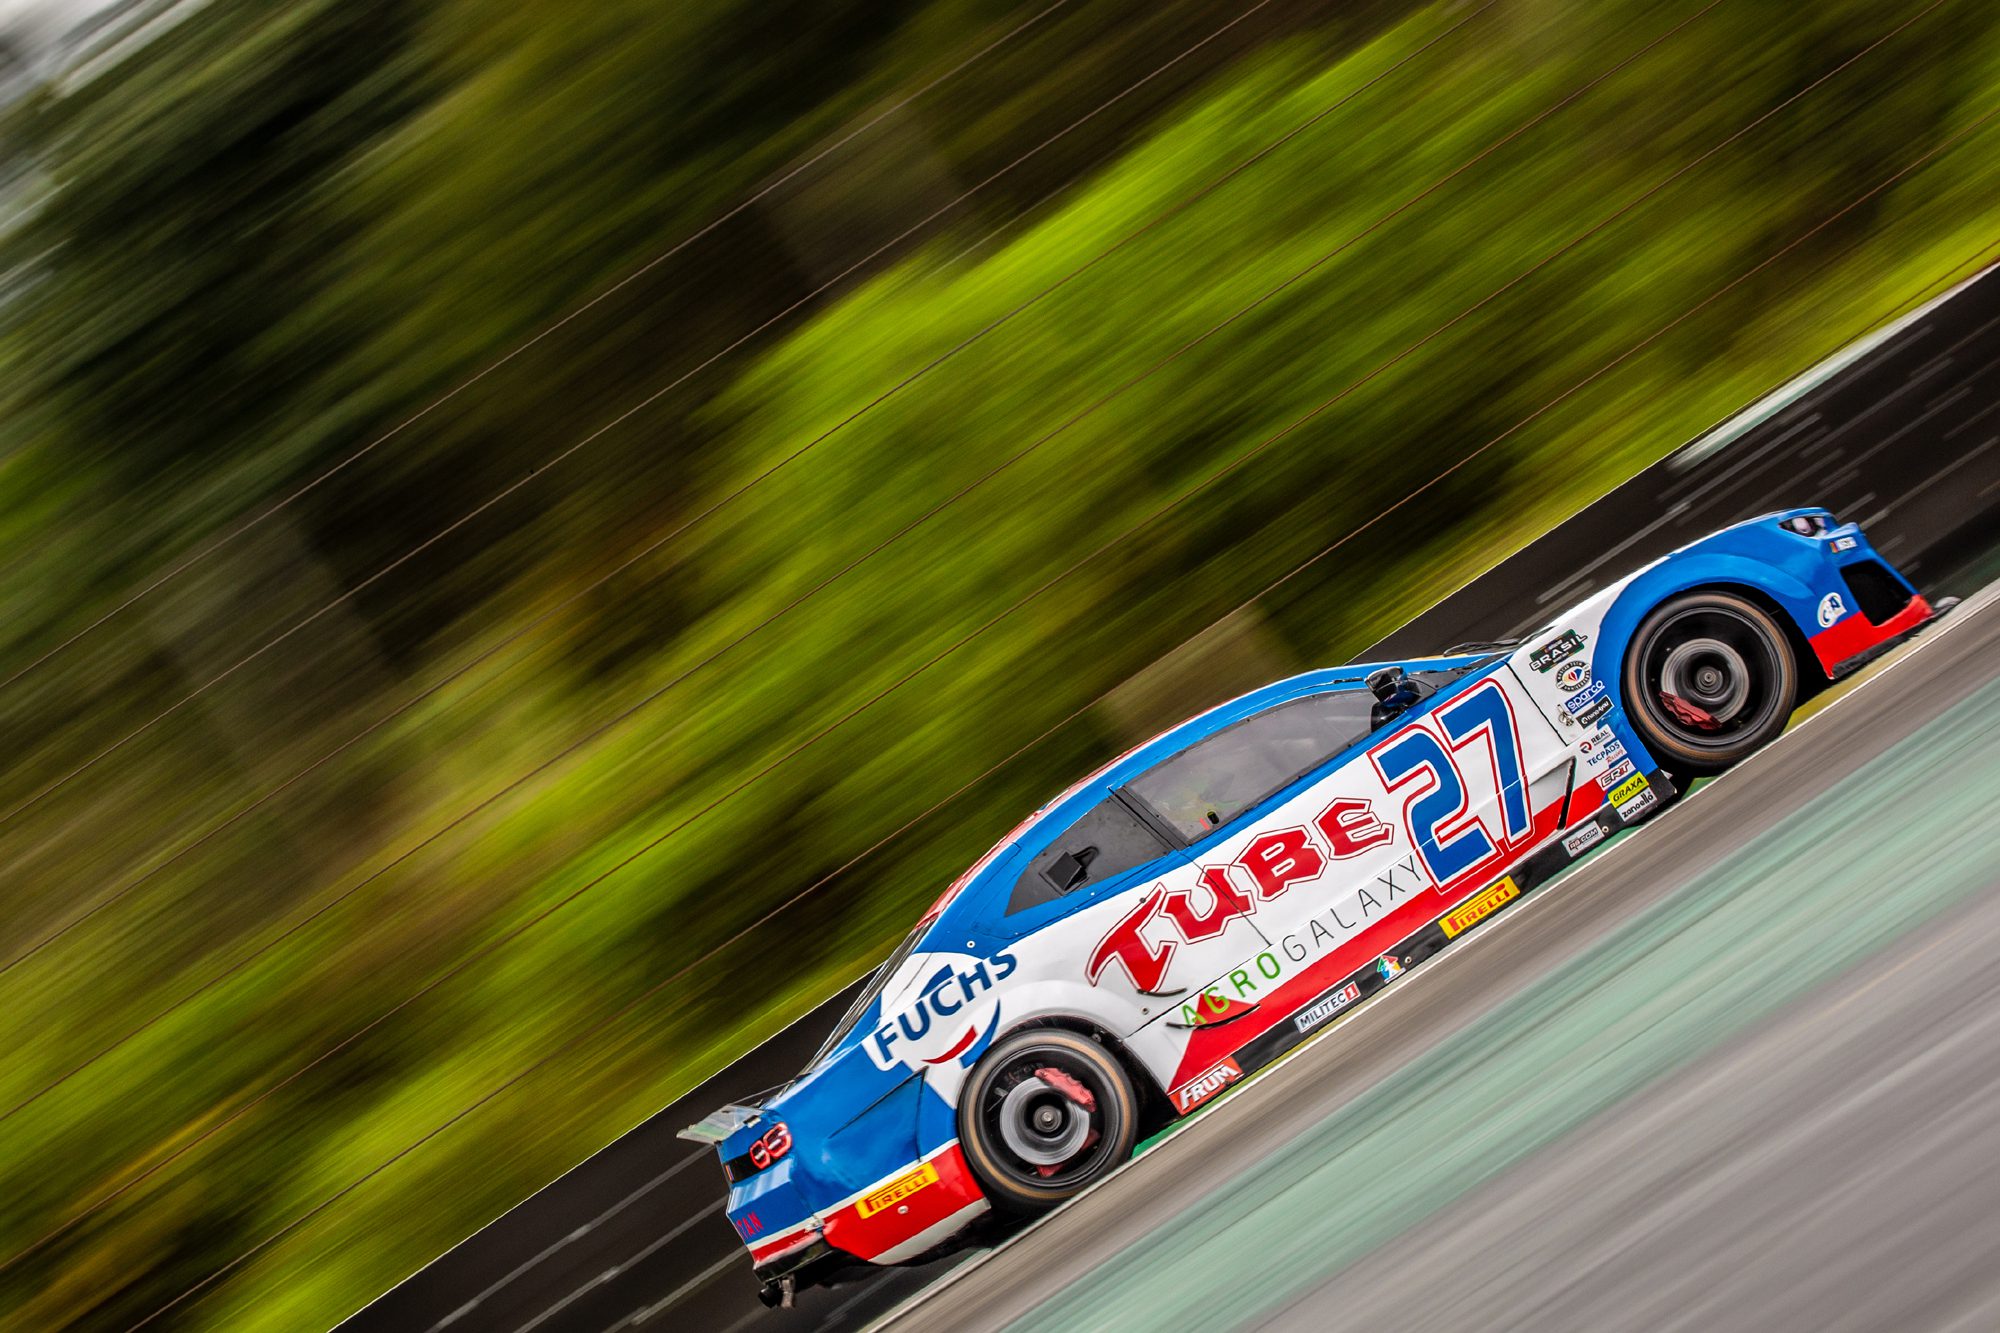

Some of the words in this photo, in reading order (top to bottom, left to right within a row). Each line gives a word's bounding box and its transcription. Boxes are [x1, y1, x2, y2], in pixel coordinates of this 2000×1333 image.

[1530, 634, 1588, 671] BRASIL
[1567, 680, 1604, 710] sparco
[1587, 742, 1620, 766] TECPADS
[1591, 730, 1608, 743] REAL
[1367, 678, 1535, 894] 27
[1613, 777, 1643, 802] GRAXA
[1085, 798, 1395, 993] TUBE
[1447, 883, 1510, 932] PIRELLI
[874, 953, 1017, 1063] FUCHS
[1179, 1063, 1240, 1110] FRUM
[863, 1169, 929, 1213] PIRELLI
